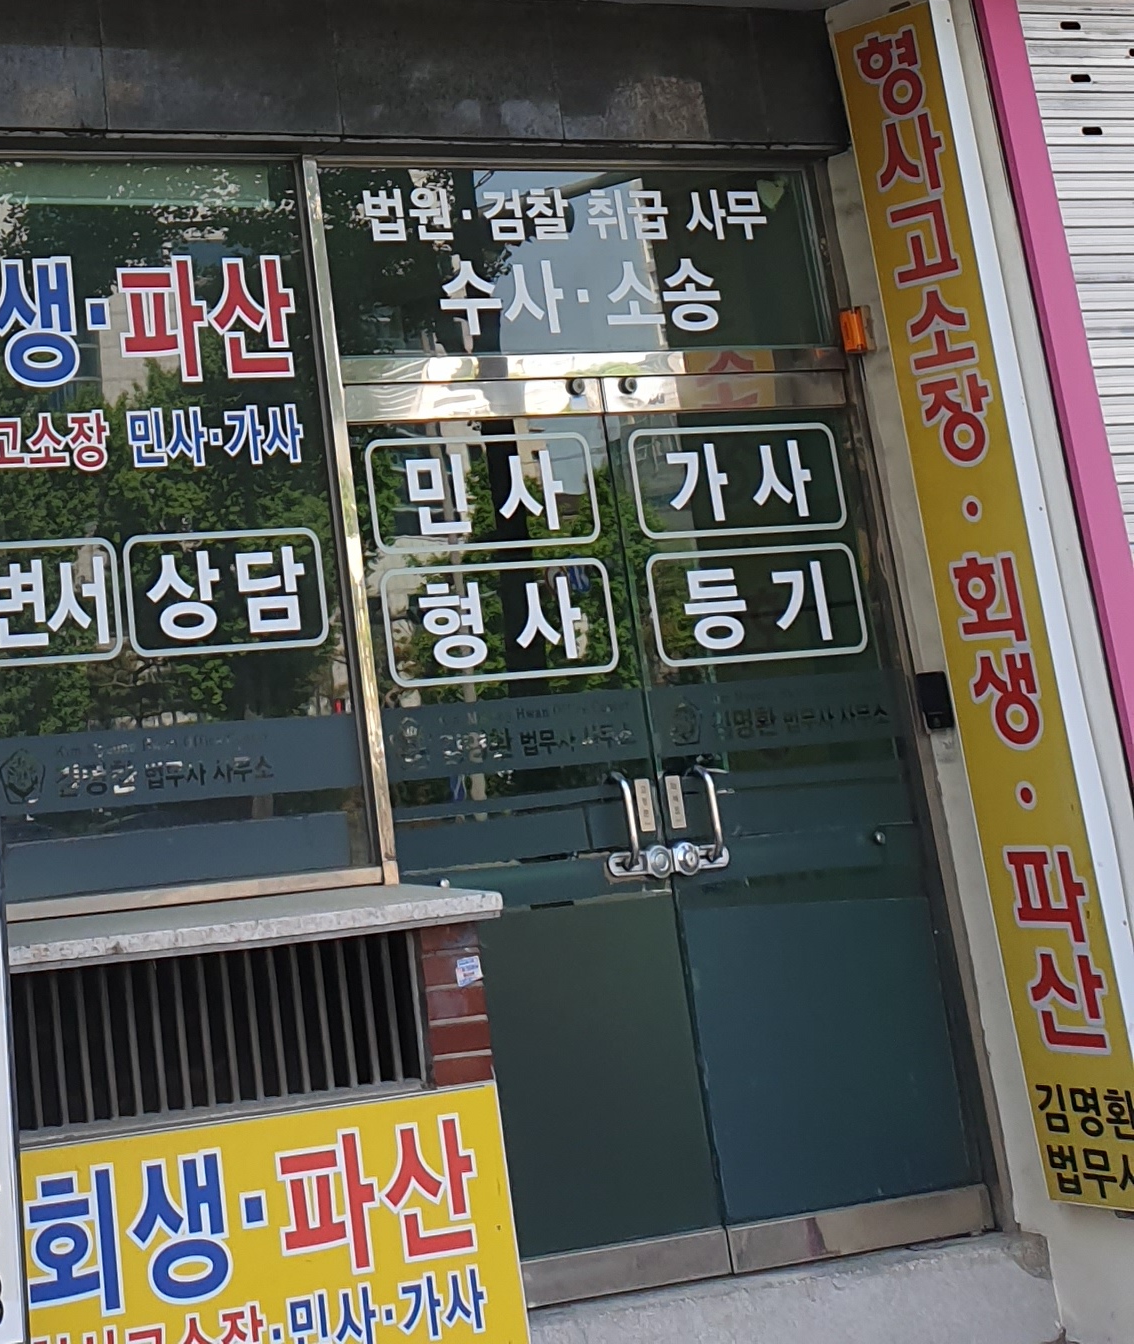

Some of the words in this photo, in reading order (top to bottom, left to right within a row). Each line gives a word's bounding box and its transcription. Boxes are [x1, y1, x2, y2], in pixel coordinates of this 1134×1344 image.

[587, 186, 669, 242] 취급
[686, 188, 768, 243] 사무
[404, 448, 565, 537] 민사
[666, 438, 813, 523] 가사
[146, 545, 307, 642] 상담
[418, 580, 583, 671] 형사
[683, 559, 835, 650] 등기
